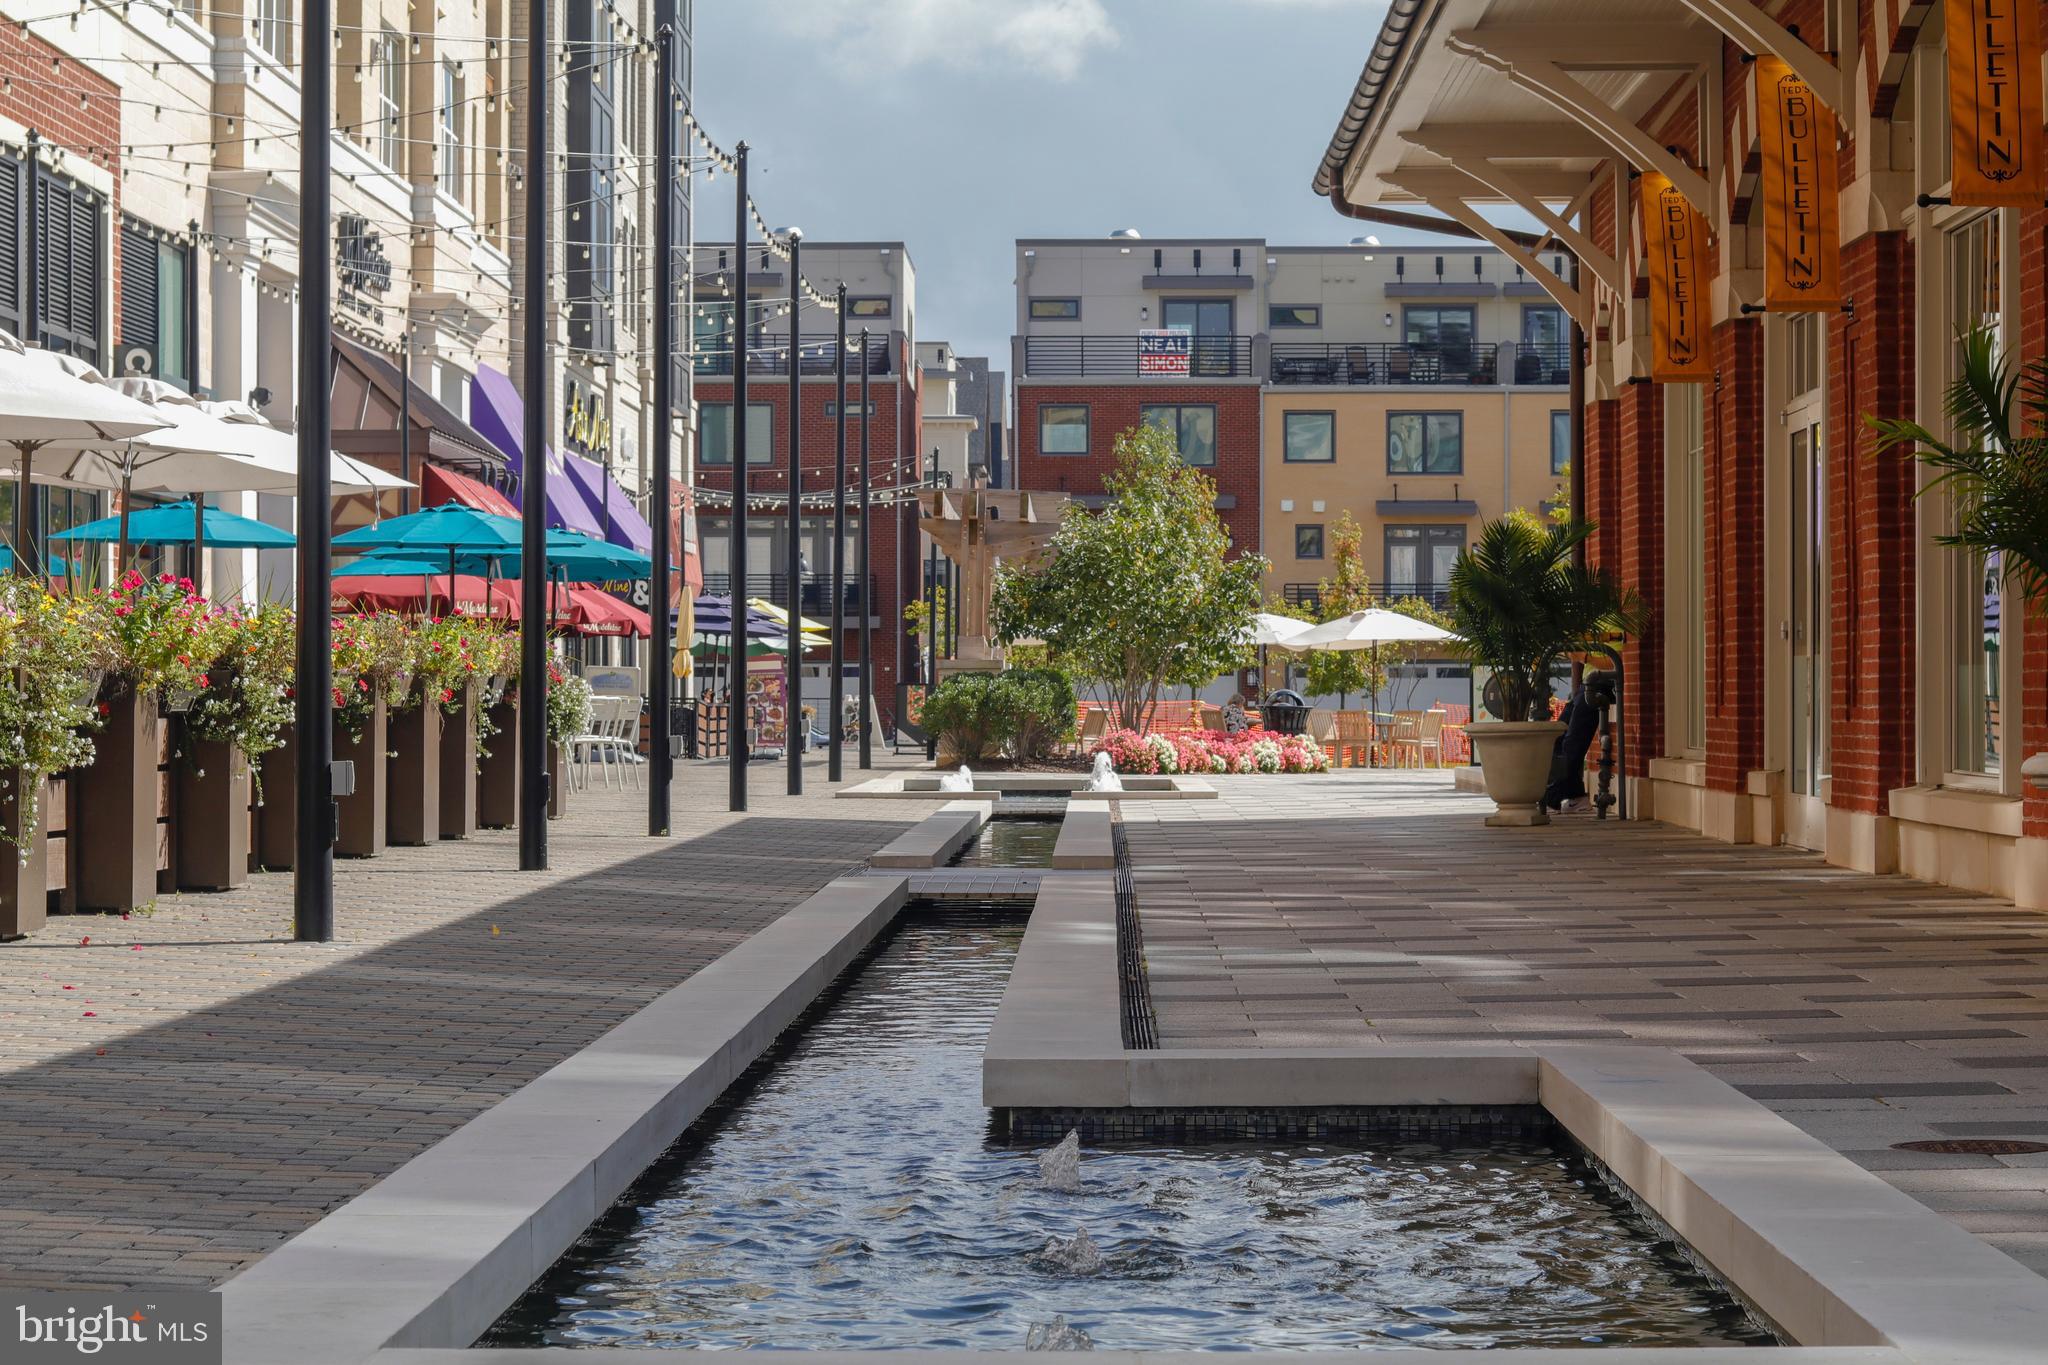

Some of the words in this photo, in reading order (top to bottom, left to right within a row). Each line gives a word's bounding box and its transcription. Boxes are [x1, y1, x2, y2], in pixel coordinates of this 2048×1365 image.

[1782, 85, 1810, 95] TED'S
[1786, 97, 1813, 277] BULLETIN
[1667, 205, 1691, 354] BULLETIN
[1142, 338, 1187, 351] NEAL
[1142, 356, 1190, 370] SIMON
[601, 579, 629, 593] Nine
